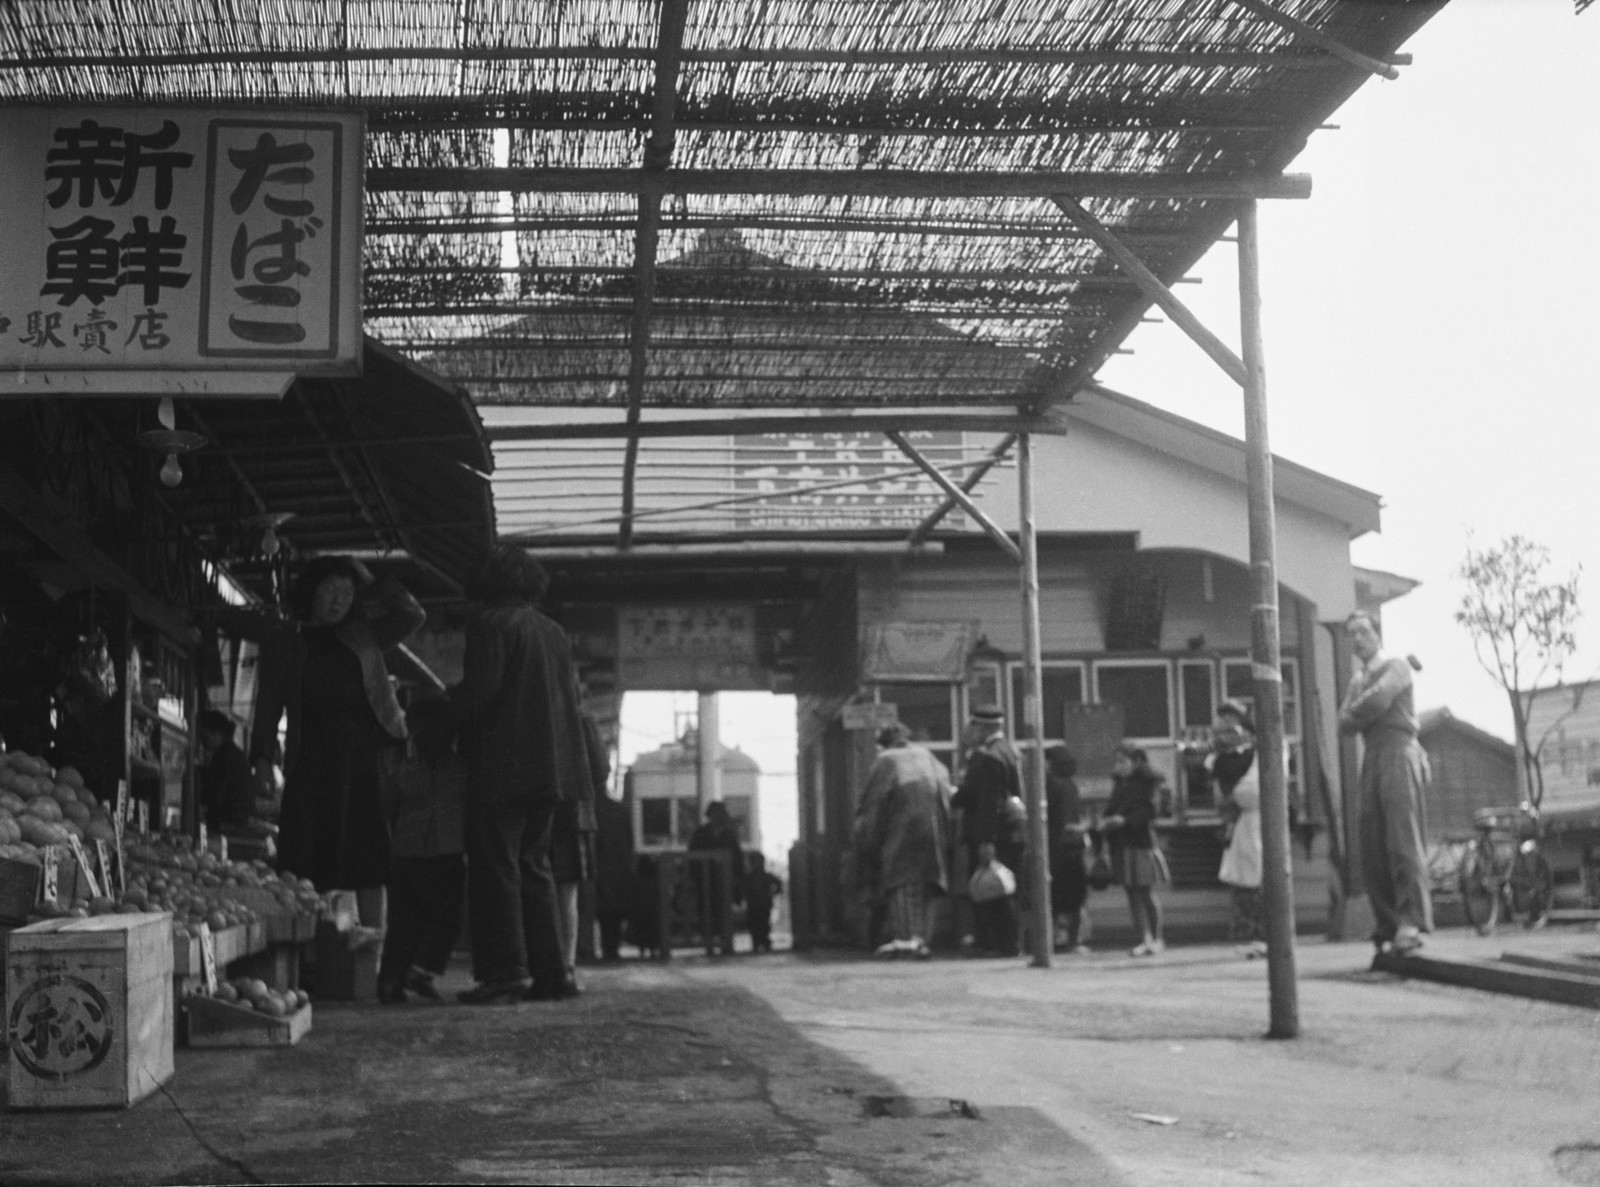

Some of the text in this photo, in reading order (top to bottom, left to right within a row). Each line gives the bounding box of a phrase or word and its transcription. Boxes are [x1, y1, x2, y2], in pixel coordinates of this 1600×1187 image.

[40, 118, 194, 306] 新鮮
[228, 132, 324, 344] たばこ
[0, 308, 171, 354] 駅賣店
